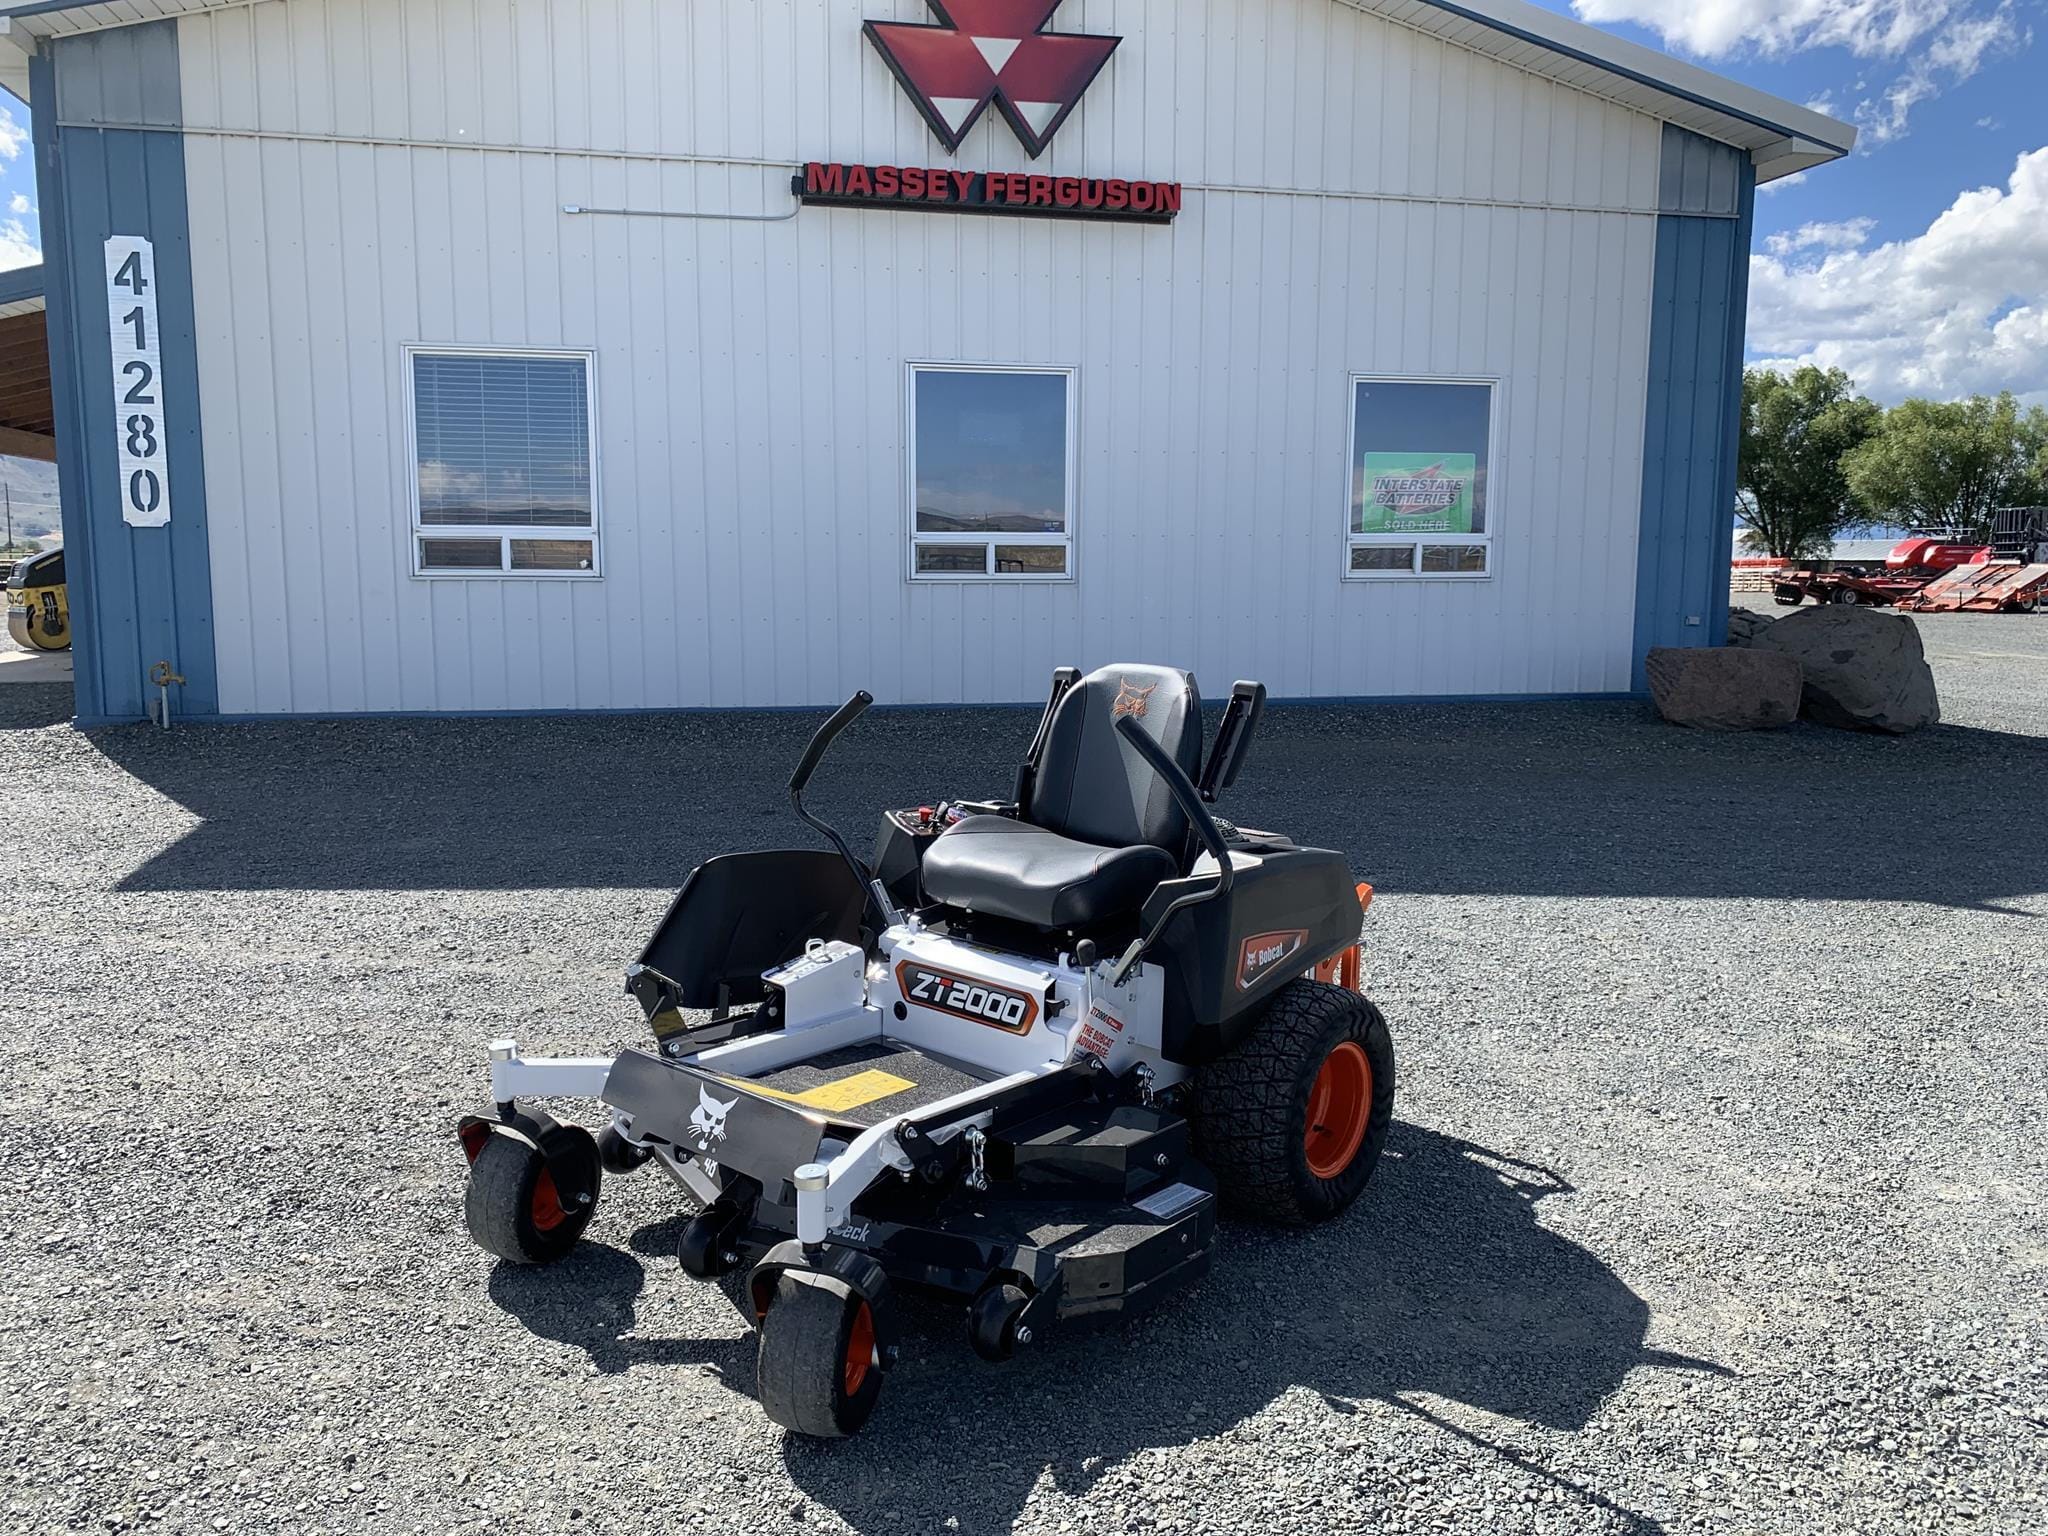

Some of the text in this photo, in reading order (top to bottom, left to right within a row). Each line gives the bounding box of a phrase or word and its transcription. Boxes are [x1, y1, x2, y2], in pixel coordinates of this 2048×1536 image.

[807, 162, 1181, 212] MASSEY FERGUSON
[114, 251, 161, 512] 41280
[1374, 478, 1465, 491] INTERSTATE
[1375, 492, 1457, 505] BATTERIES
[1384, 520, 1451, 530] SOLD HERE
[1258, 941, 1284, 967] Bobcat
[911, 971, 1027, 1026] ZT2000
[1082, 1024, 1095, 1038] THE
[1093, 1030, 1115, 1049] BOBCAT
